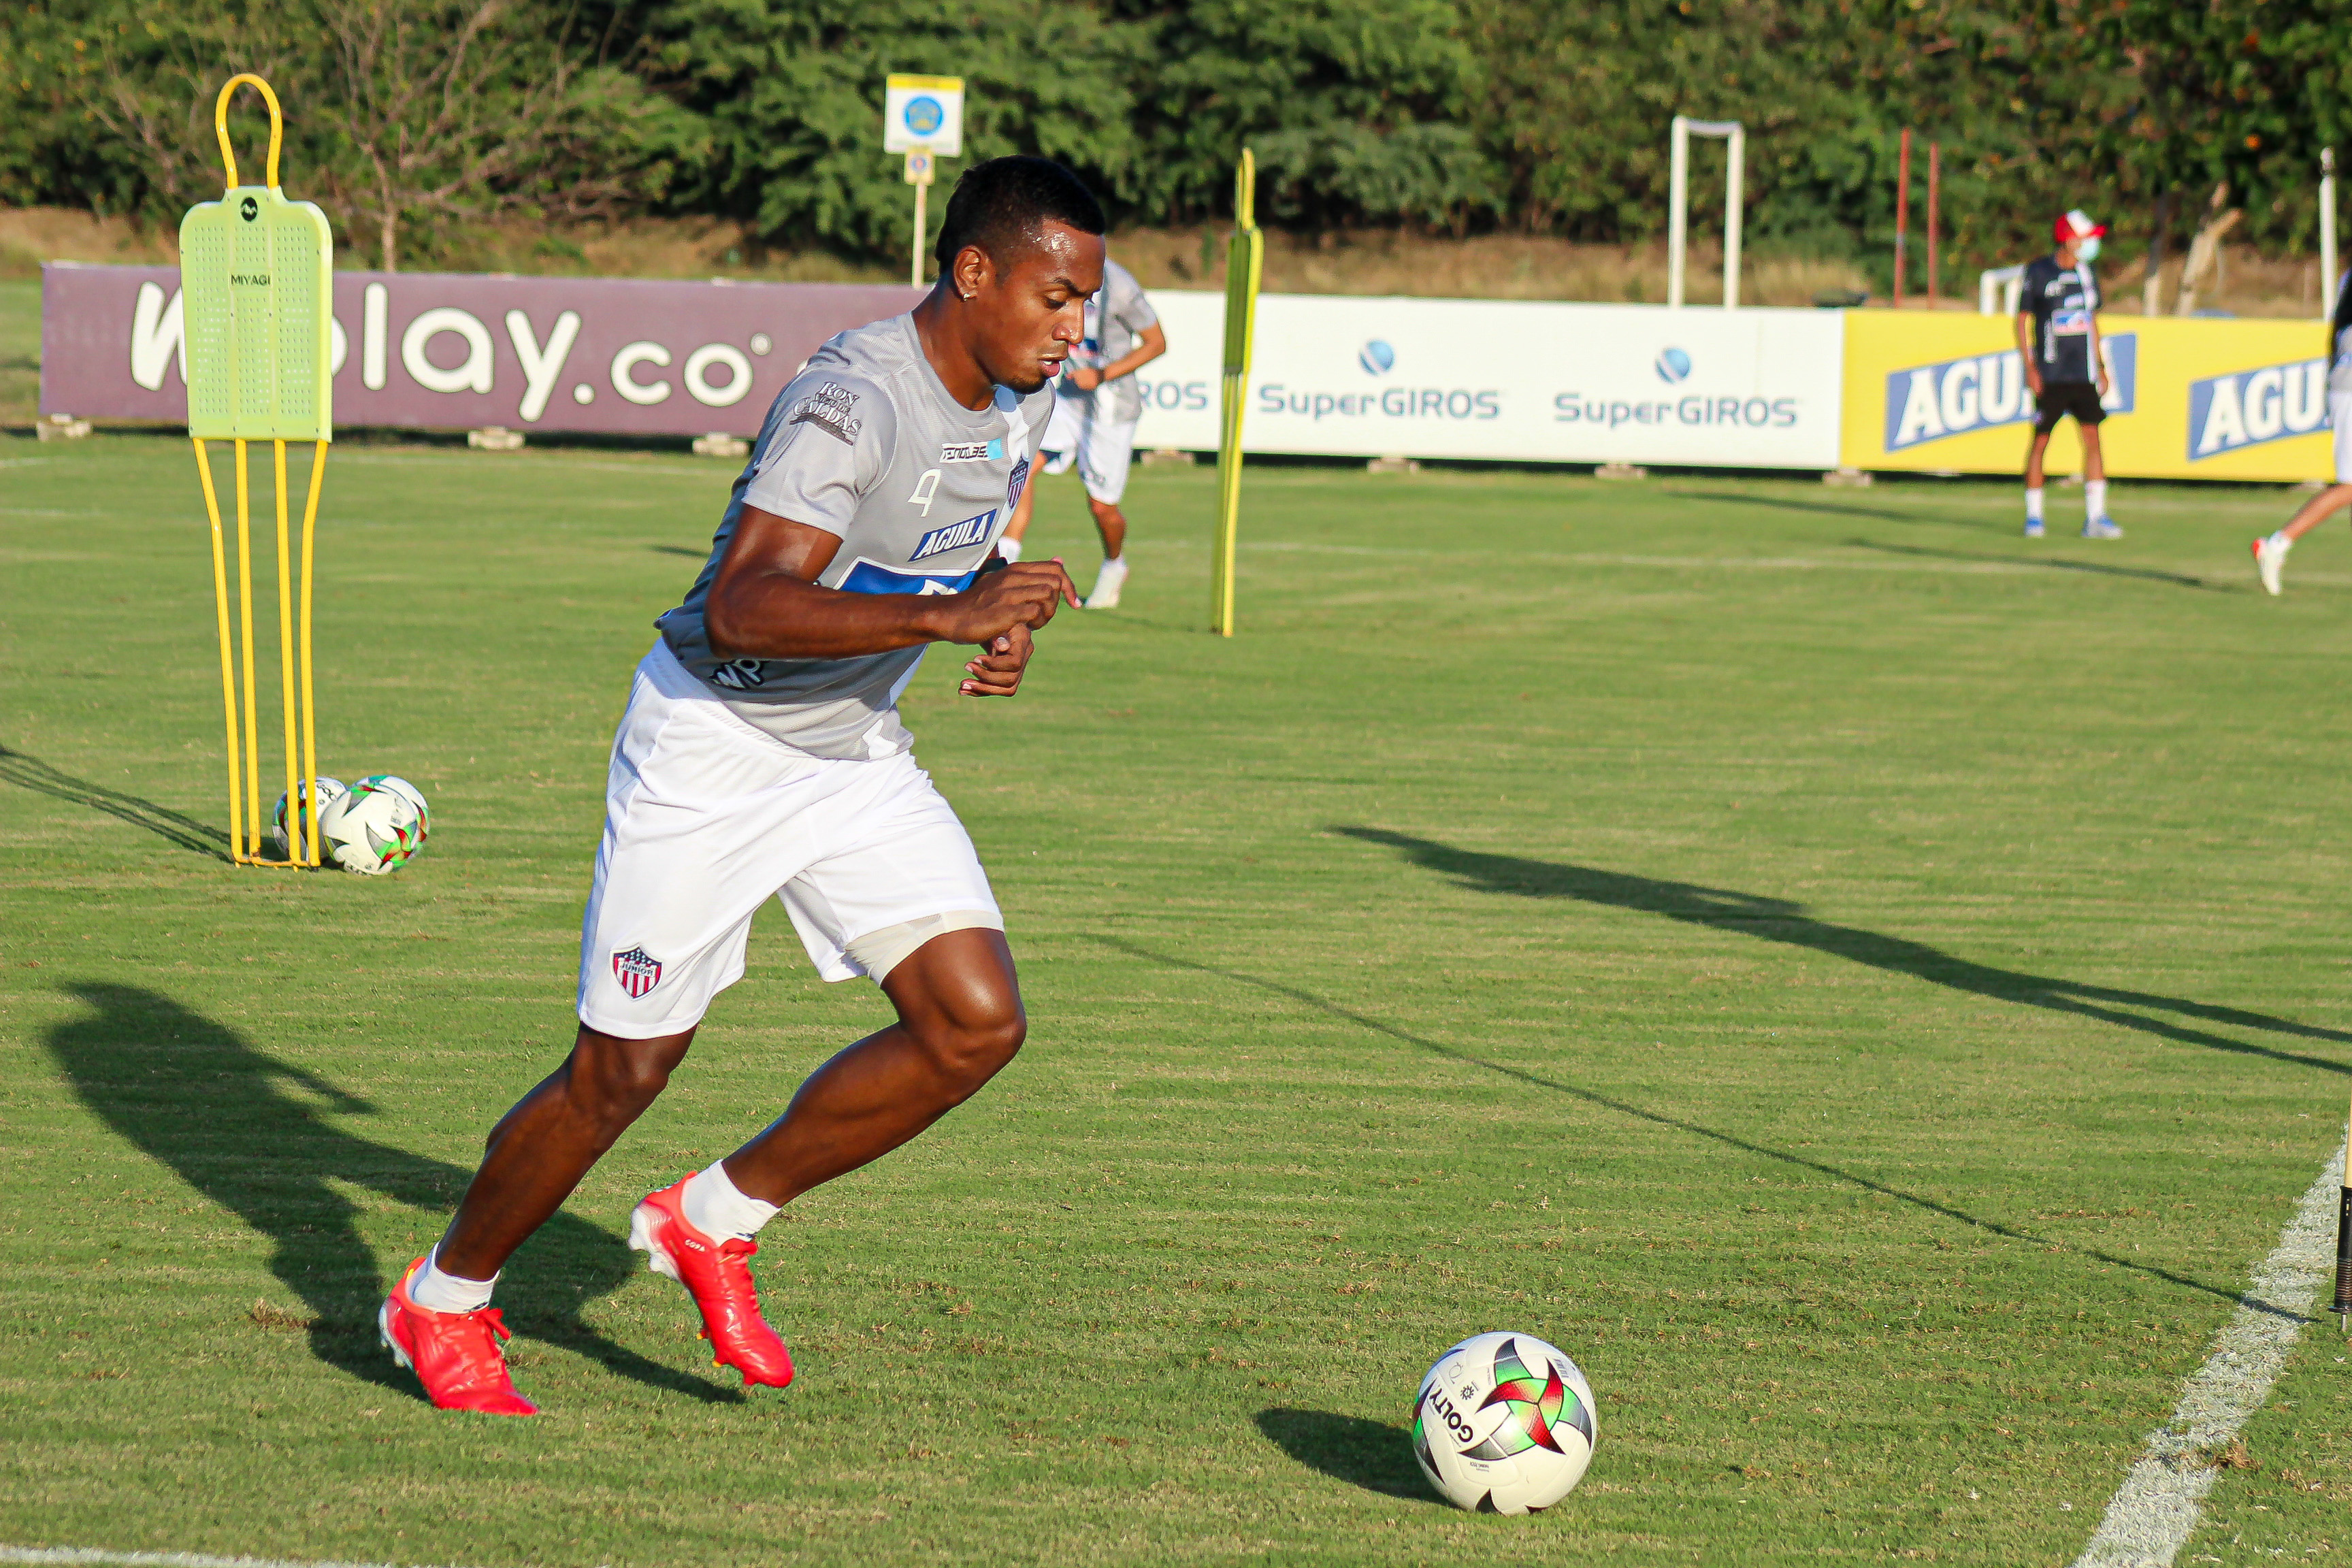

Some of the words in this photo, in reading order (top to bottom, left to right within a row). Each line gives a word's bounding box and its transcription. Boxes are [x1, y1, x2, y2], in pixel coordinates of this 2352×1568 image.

[231, 274, 271, 286] MIYAGI
[817, 381, 860, 406] RON
[1258, 383, 1501, 421] SuperGIROS
[1554, 392, 1798, 429] SuperGIROS
[793, 397, 862, 436] CALDAS
[913, 513, 991, 559] AGUILA
[620, 962, 653, 976] JUNIOR
[1429, 1387, 1473, 1443] GOLTY
